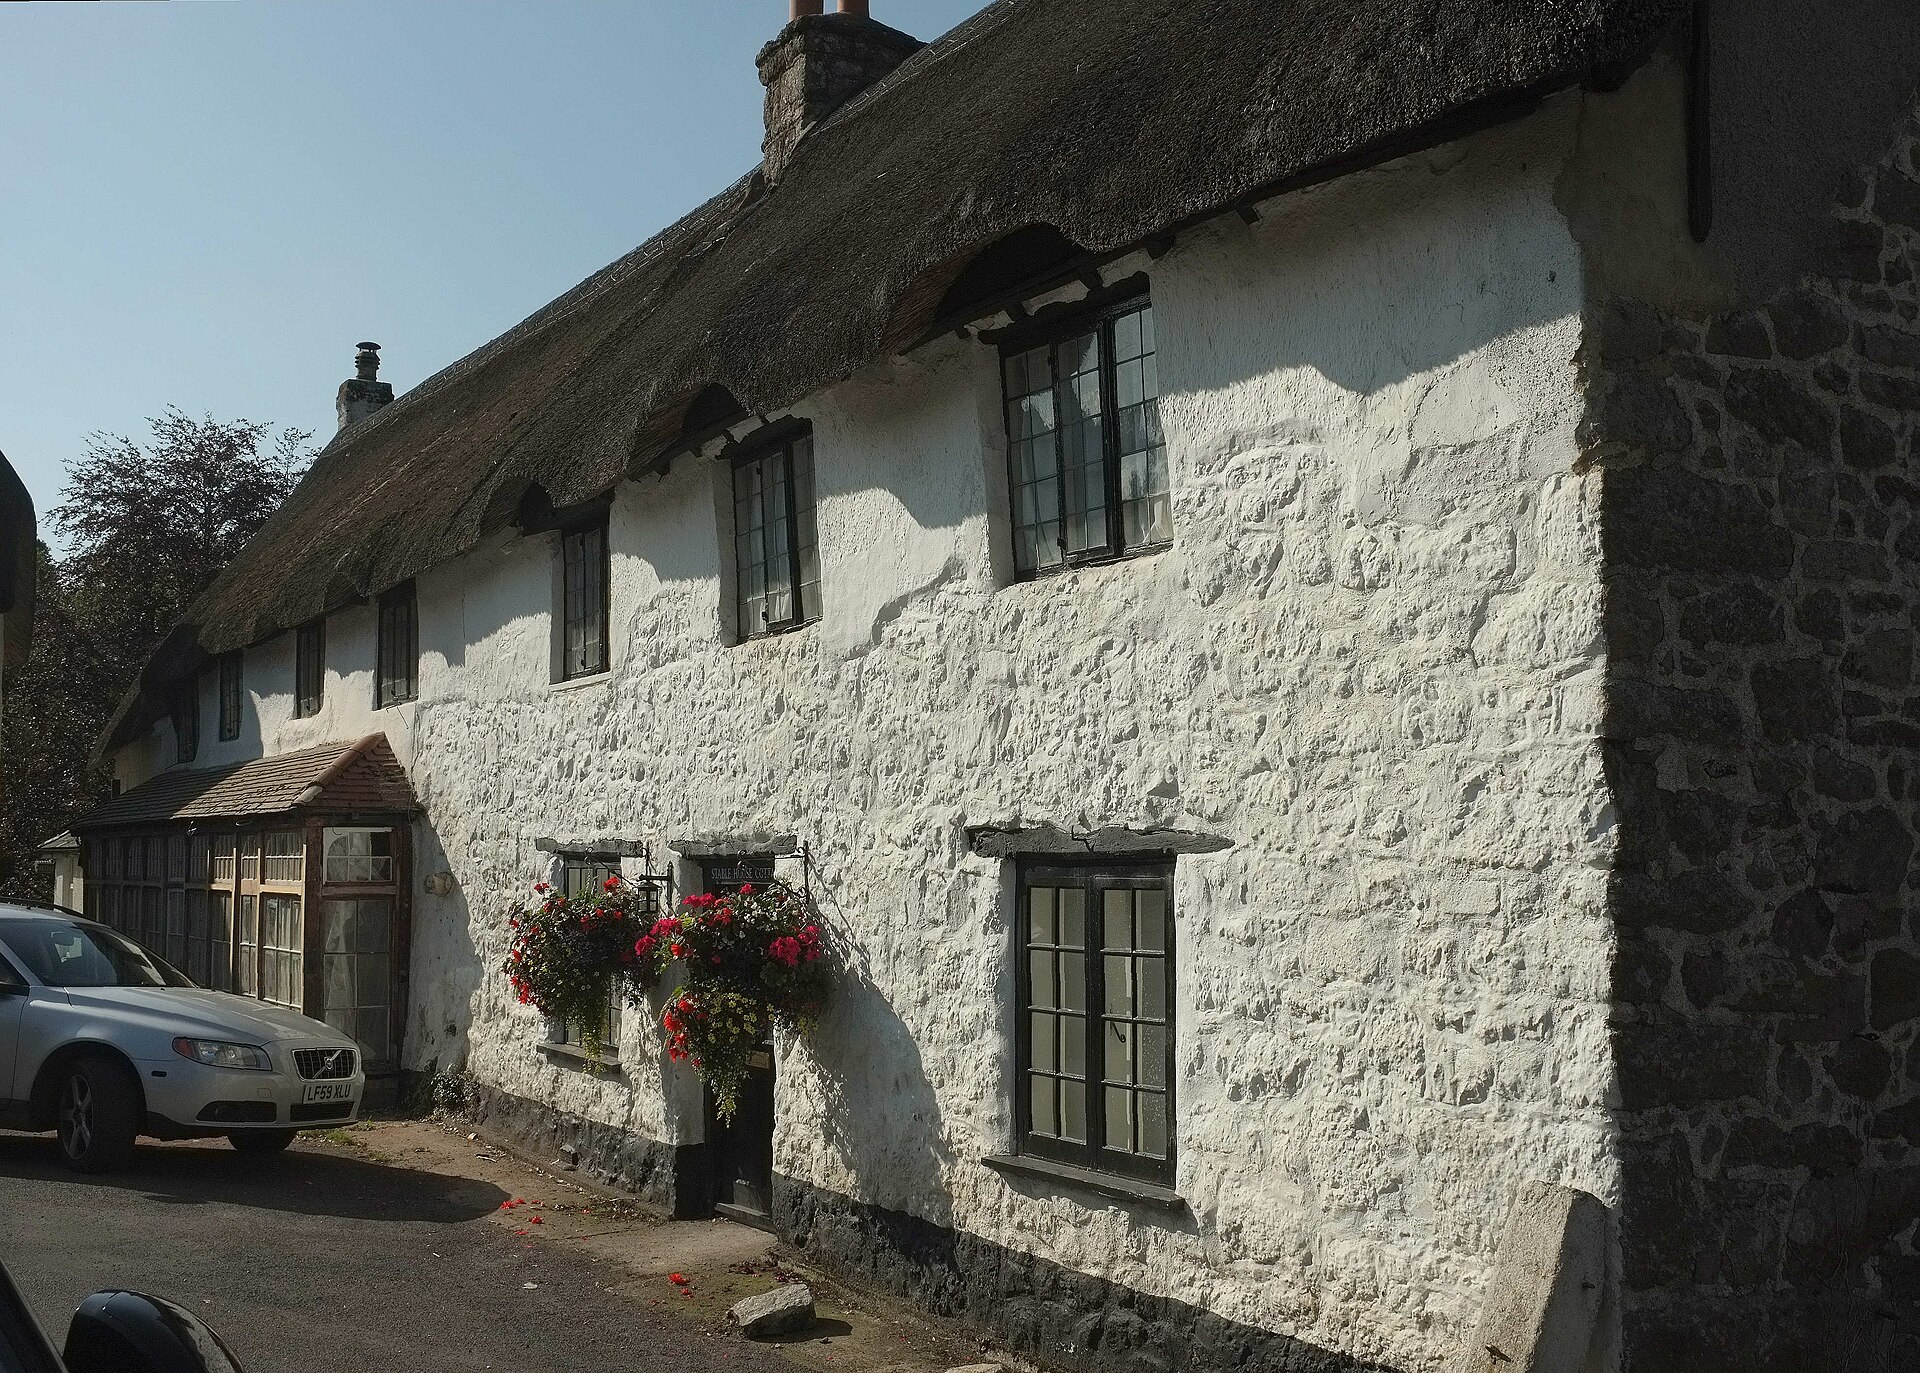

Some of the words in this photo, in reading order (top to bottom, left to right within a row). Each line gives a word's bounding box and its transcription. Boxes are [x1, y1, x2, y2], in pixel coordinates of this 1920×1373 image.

[711, 868, 731, 879] STABLE
[733, 868, 753, 879] HOUSE
[308, 1086, 333, 1100] LF59
[333, 1084, 351, 1098] XLU
